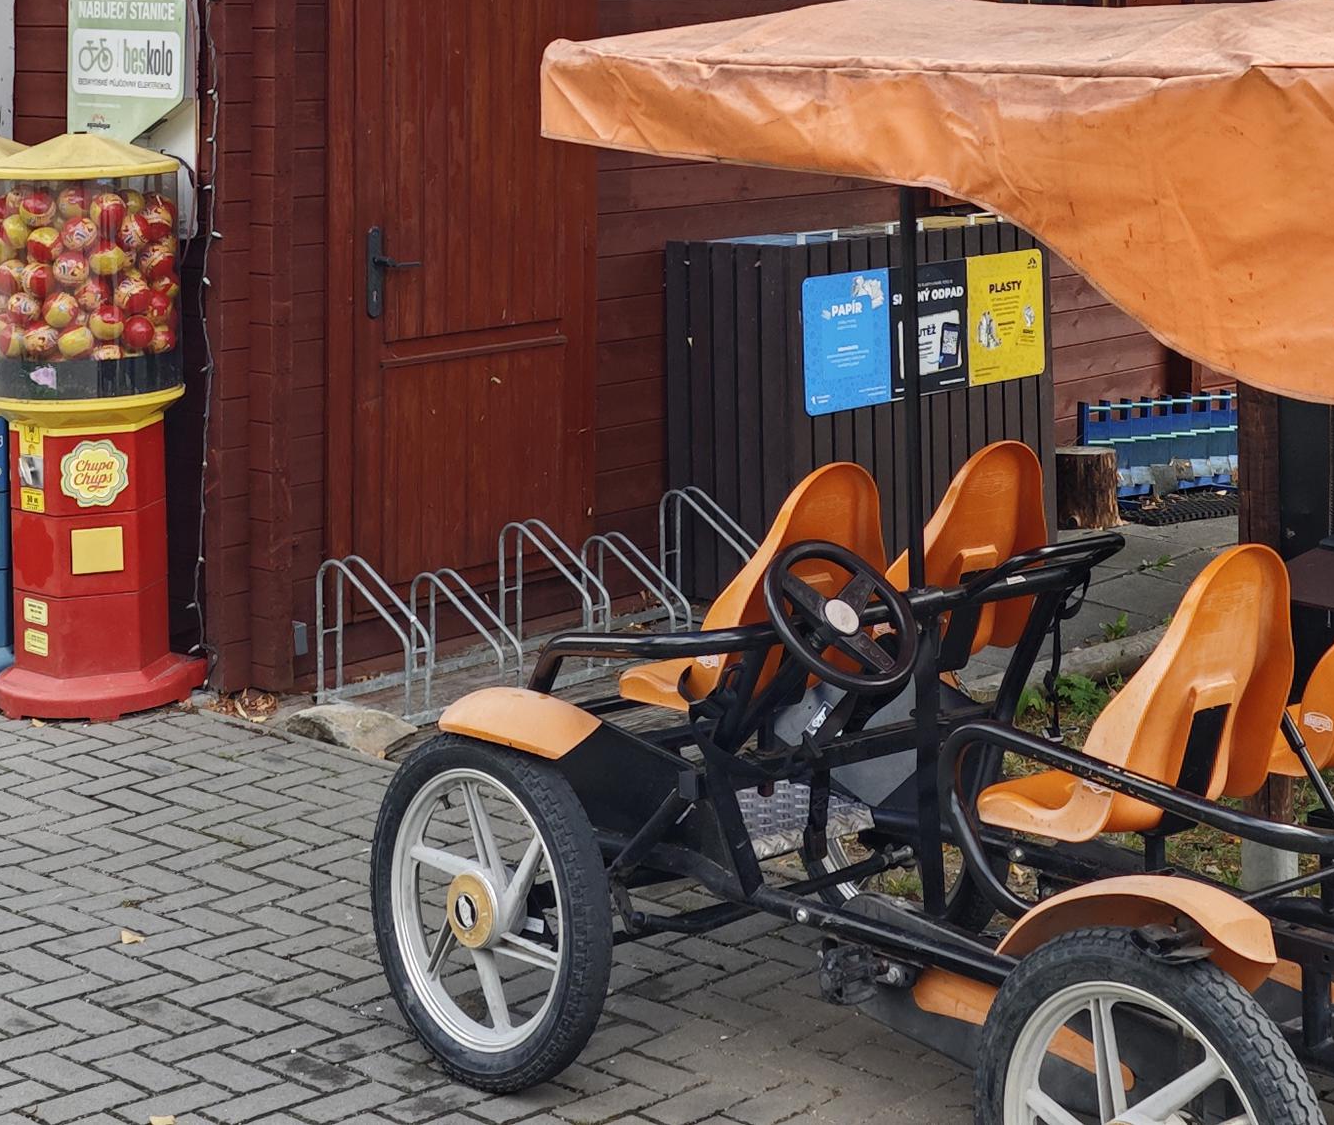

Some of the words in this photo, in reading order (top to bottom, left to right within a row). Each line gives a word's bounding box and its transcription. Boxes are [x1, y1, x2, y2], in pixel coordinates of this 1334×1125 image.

[129, 0, 175, 21] STANICE
[123, 39, 173, 77] beskolo
[931, 285, 965, 301] ODPAD
[989, 280, 1022, 293] PLASTY
[831, 299, 863, 317] PAPÍR
[75, 459, 114, 472] Chupa
[74, 472, 113, 488] Chups
